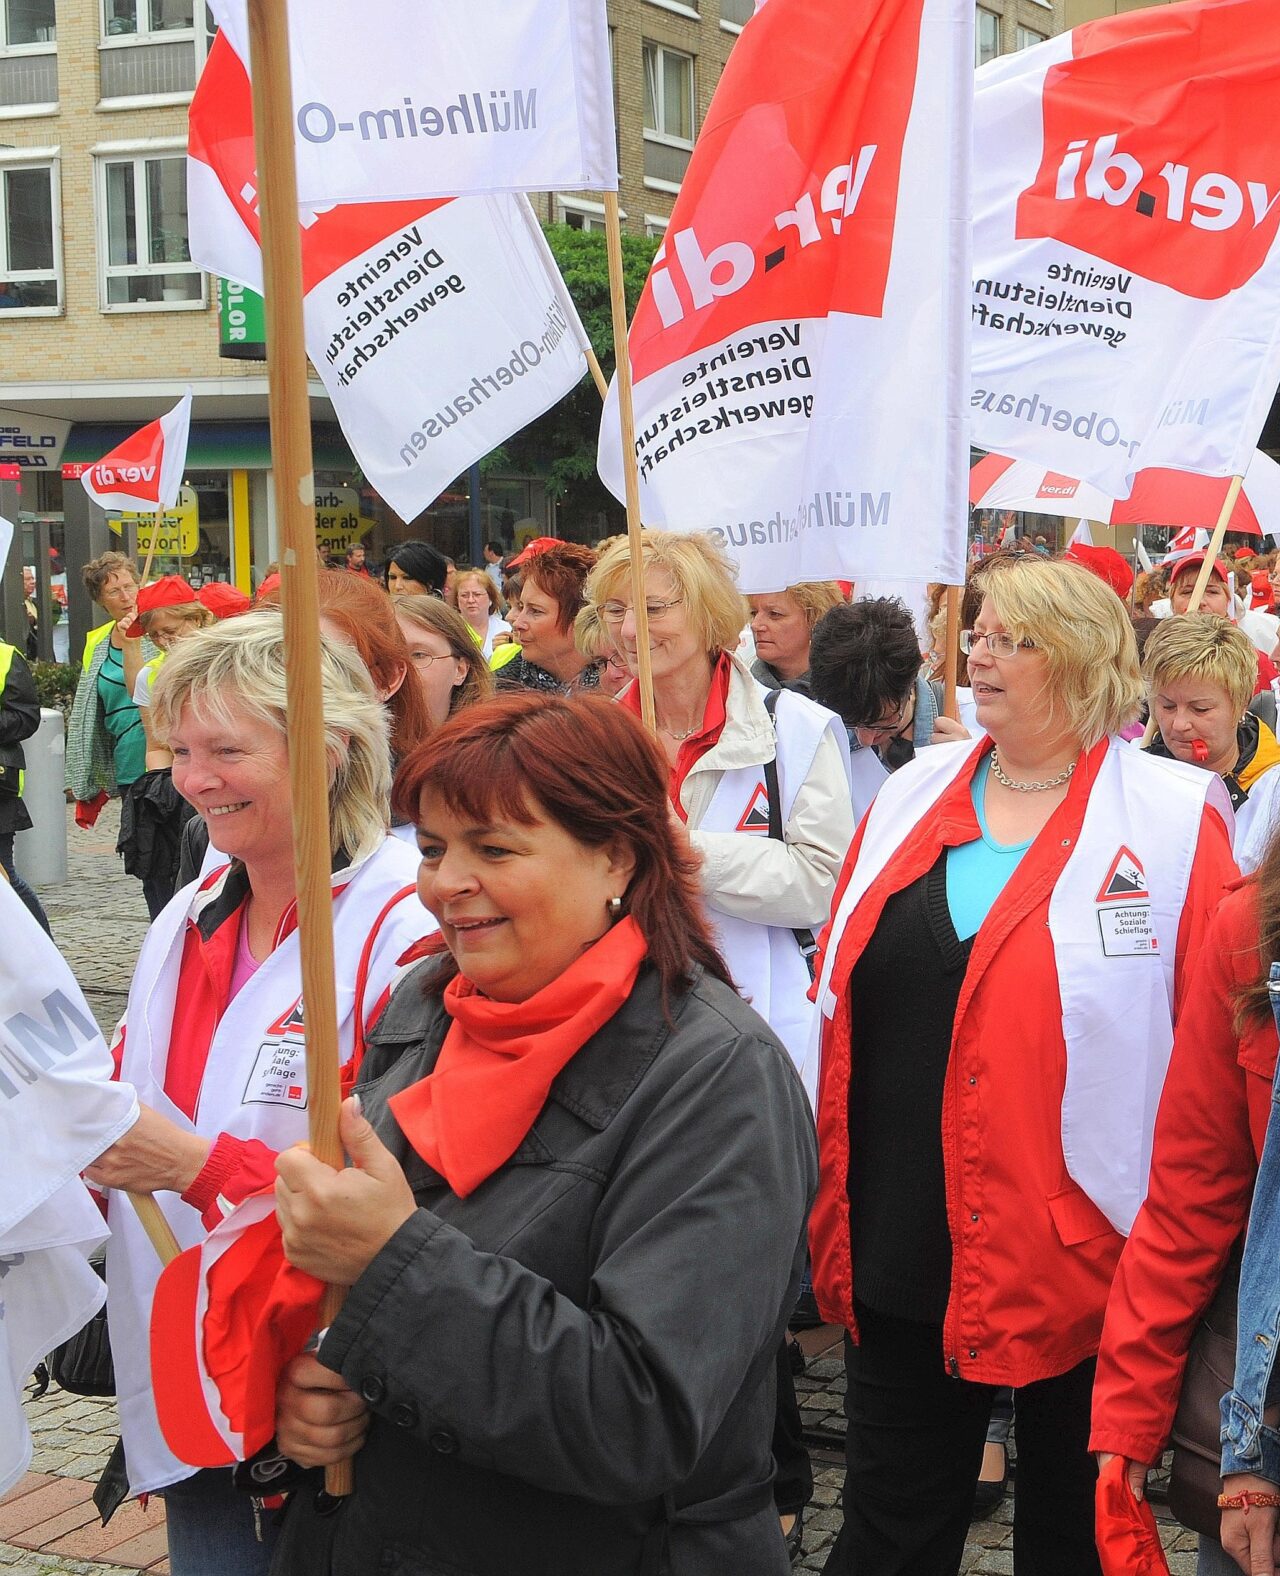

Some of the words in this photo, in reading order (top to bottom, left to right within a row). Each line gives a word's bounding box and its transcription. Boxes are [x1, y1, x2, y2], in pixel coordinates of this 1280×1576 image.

[341, 513, 358, 530] ab
[1115, 910, 1150, 919] Achtung:
[1115, 927, 1153, 935] Schieflage
